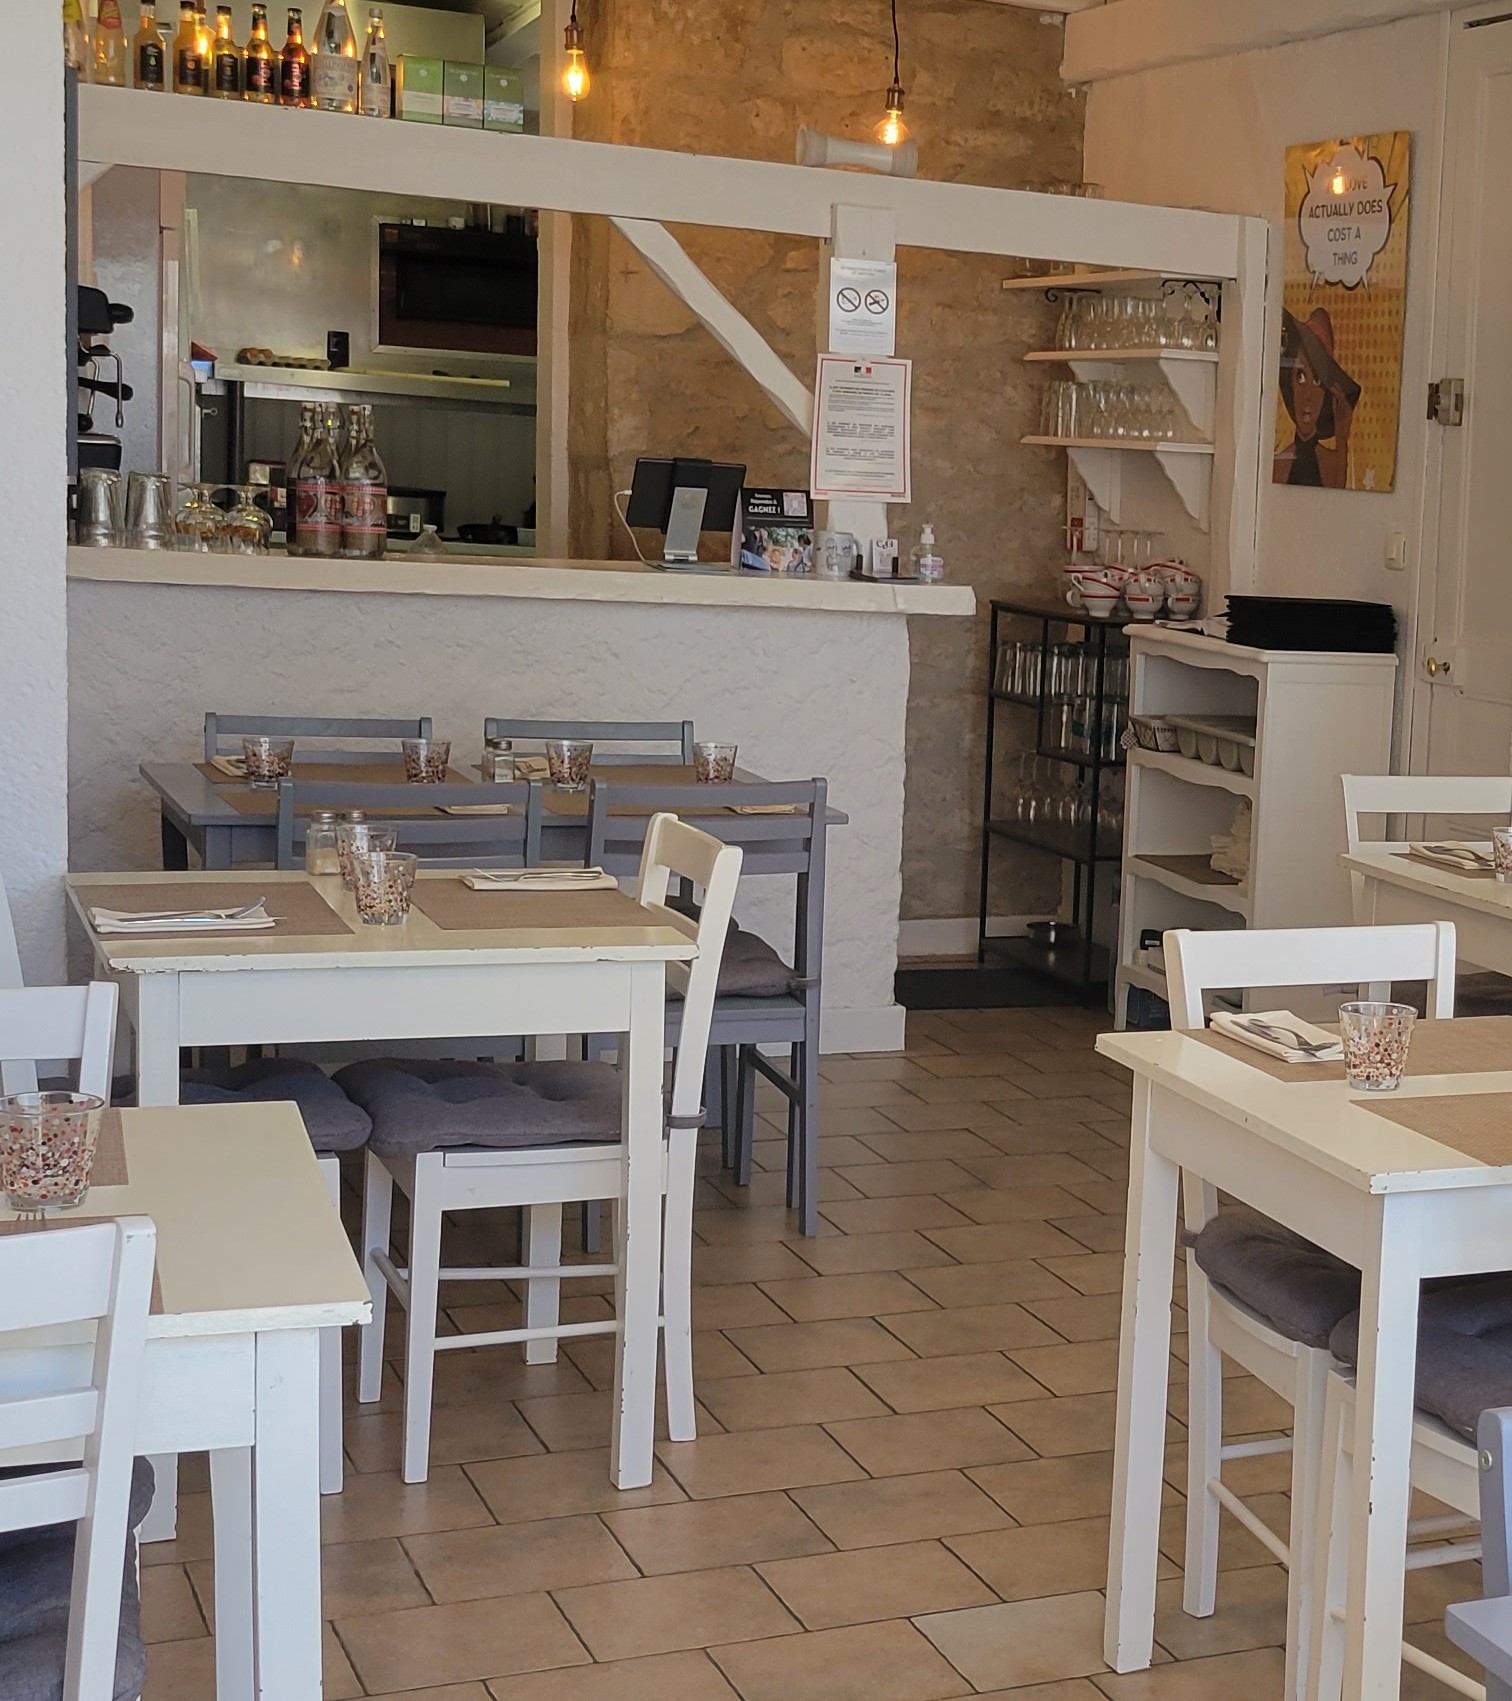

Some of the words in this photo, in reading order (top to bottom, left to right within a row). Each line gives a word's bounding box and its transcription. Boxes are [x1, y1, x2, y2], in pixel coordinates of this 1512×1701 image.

[1308, 202, 1355, 219] ACTUALLY
[1357, 199, 1383, 214] DOES
[1327, 227, 1352, 242] COST
[1355, 226, 1361, 240] A
[1333, 251, 1358, 266] THING
